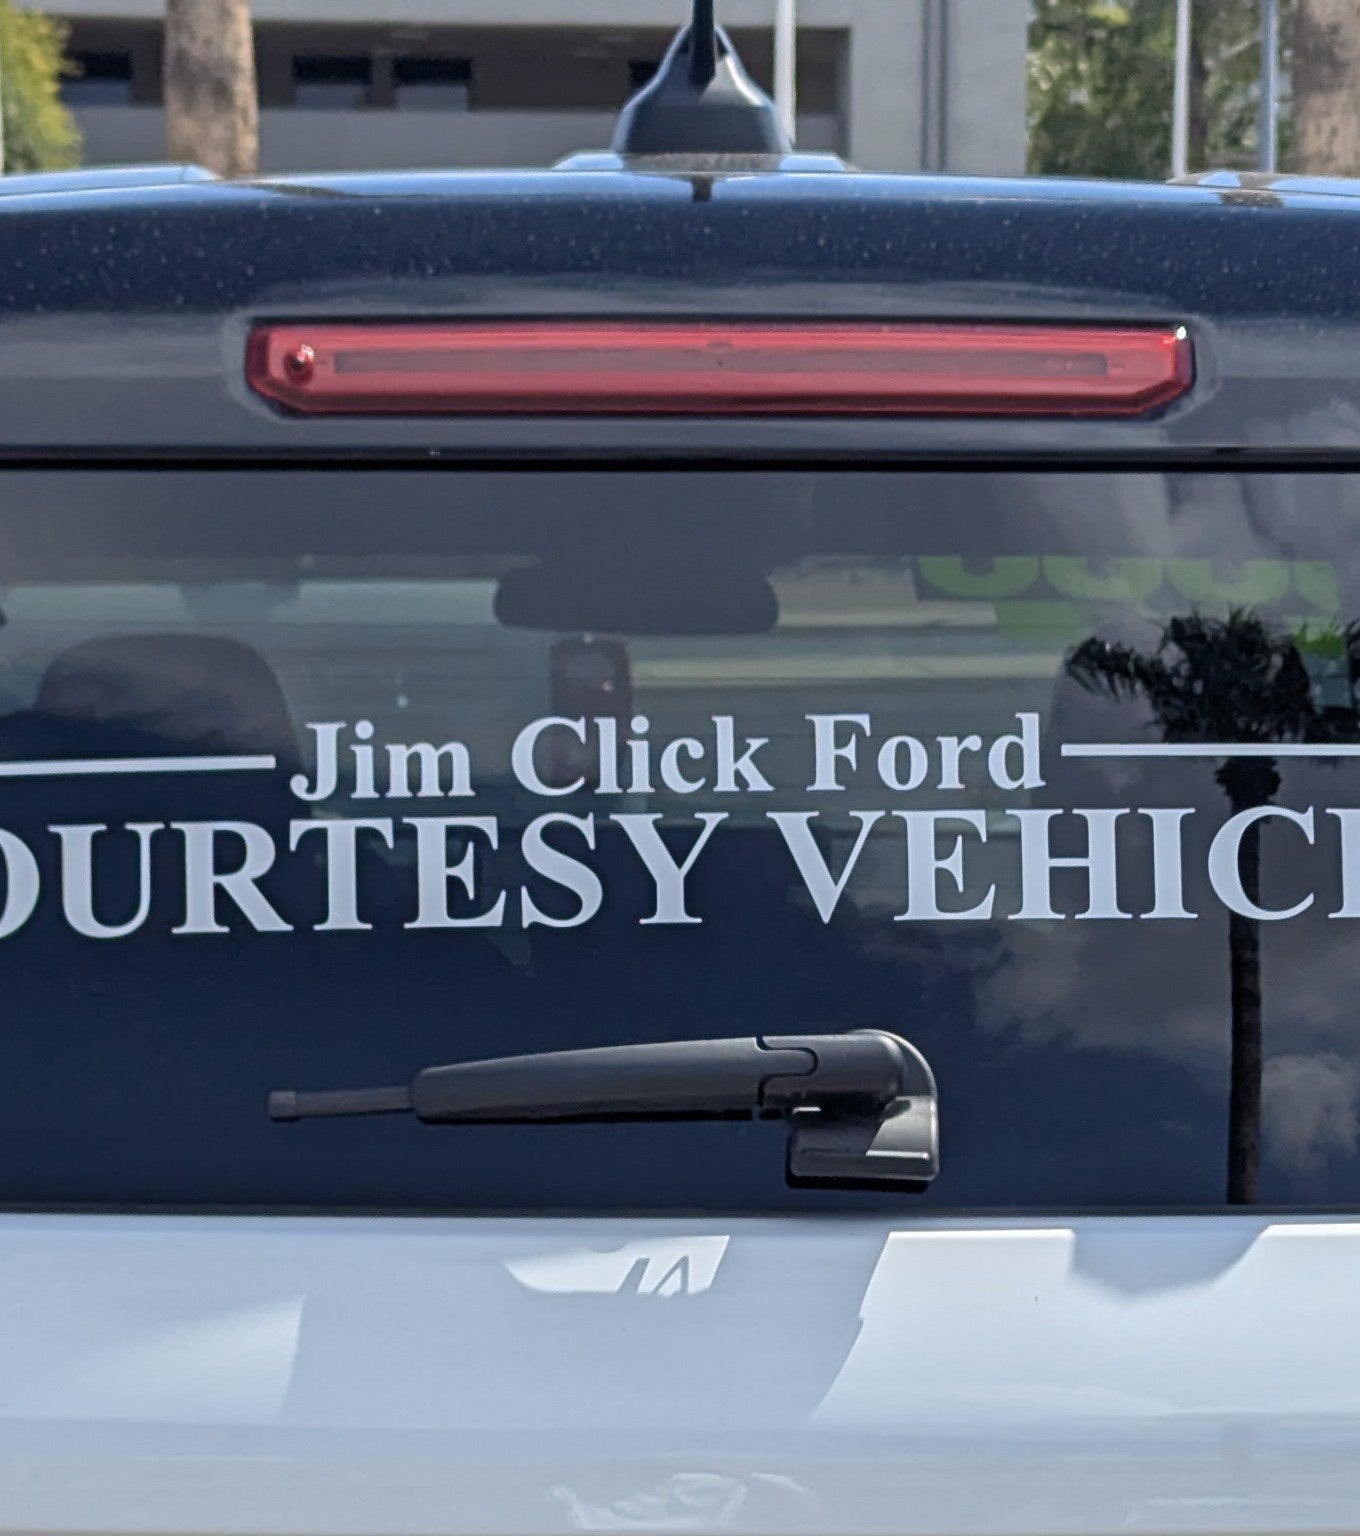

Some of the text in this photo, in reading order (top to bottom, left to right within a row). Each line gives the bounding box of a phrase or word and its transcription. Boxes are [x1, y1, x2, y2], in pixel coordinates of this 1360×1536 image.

[290, 712, 1046, 802] Jim Click Ford
